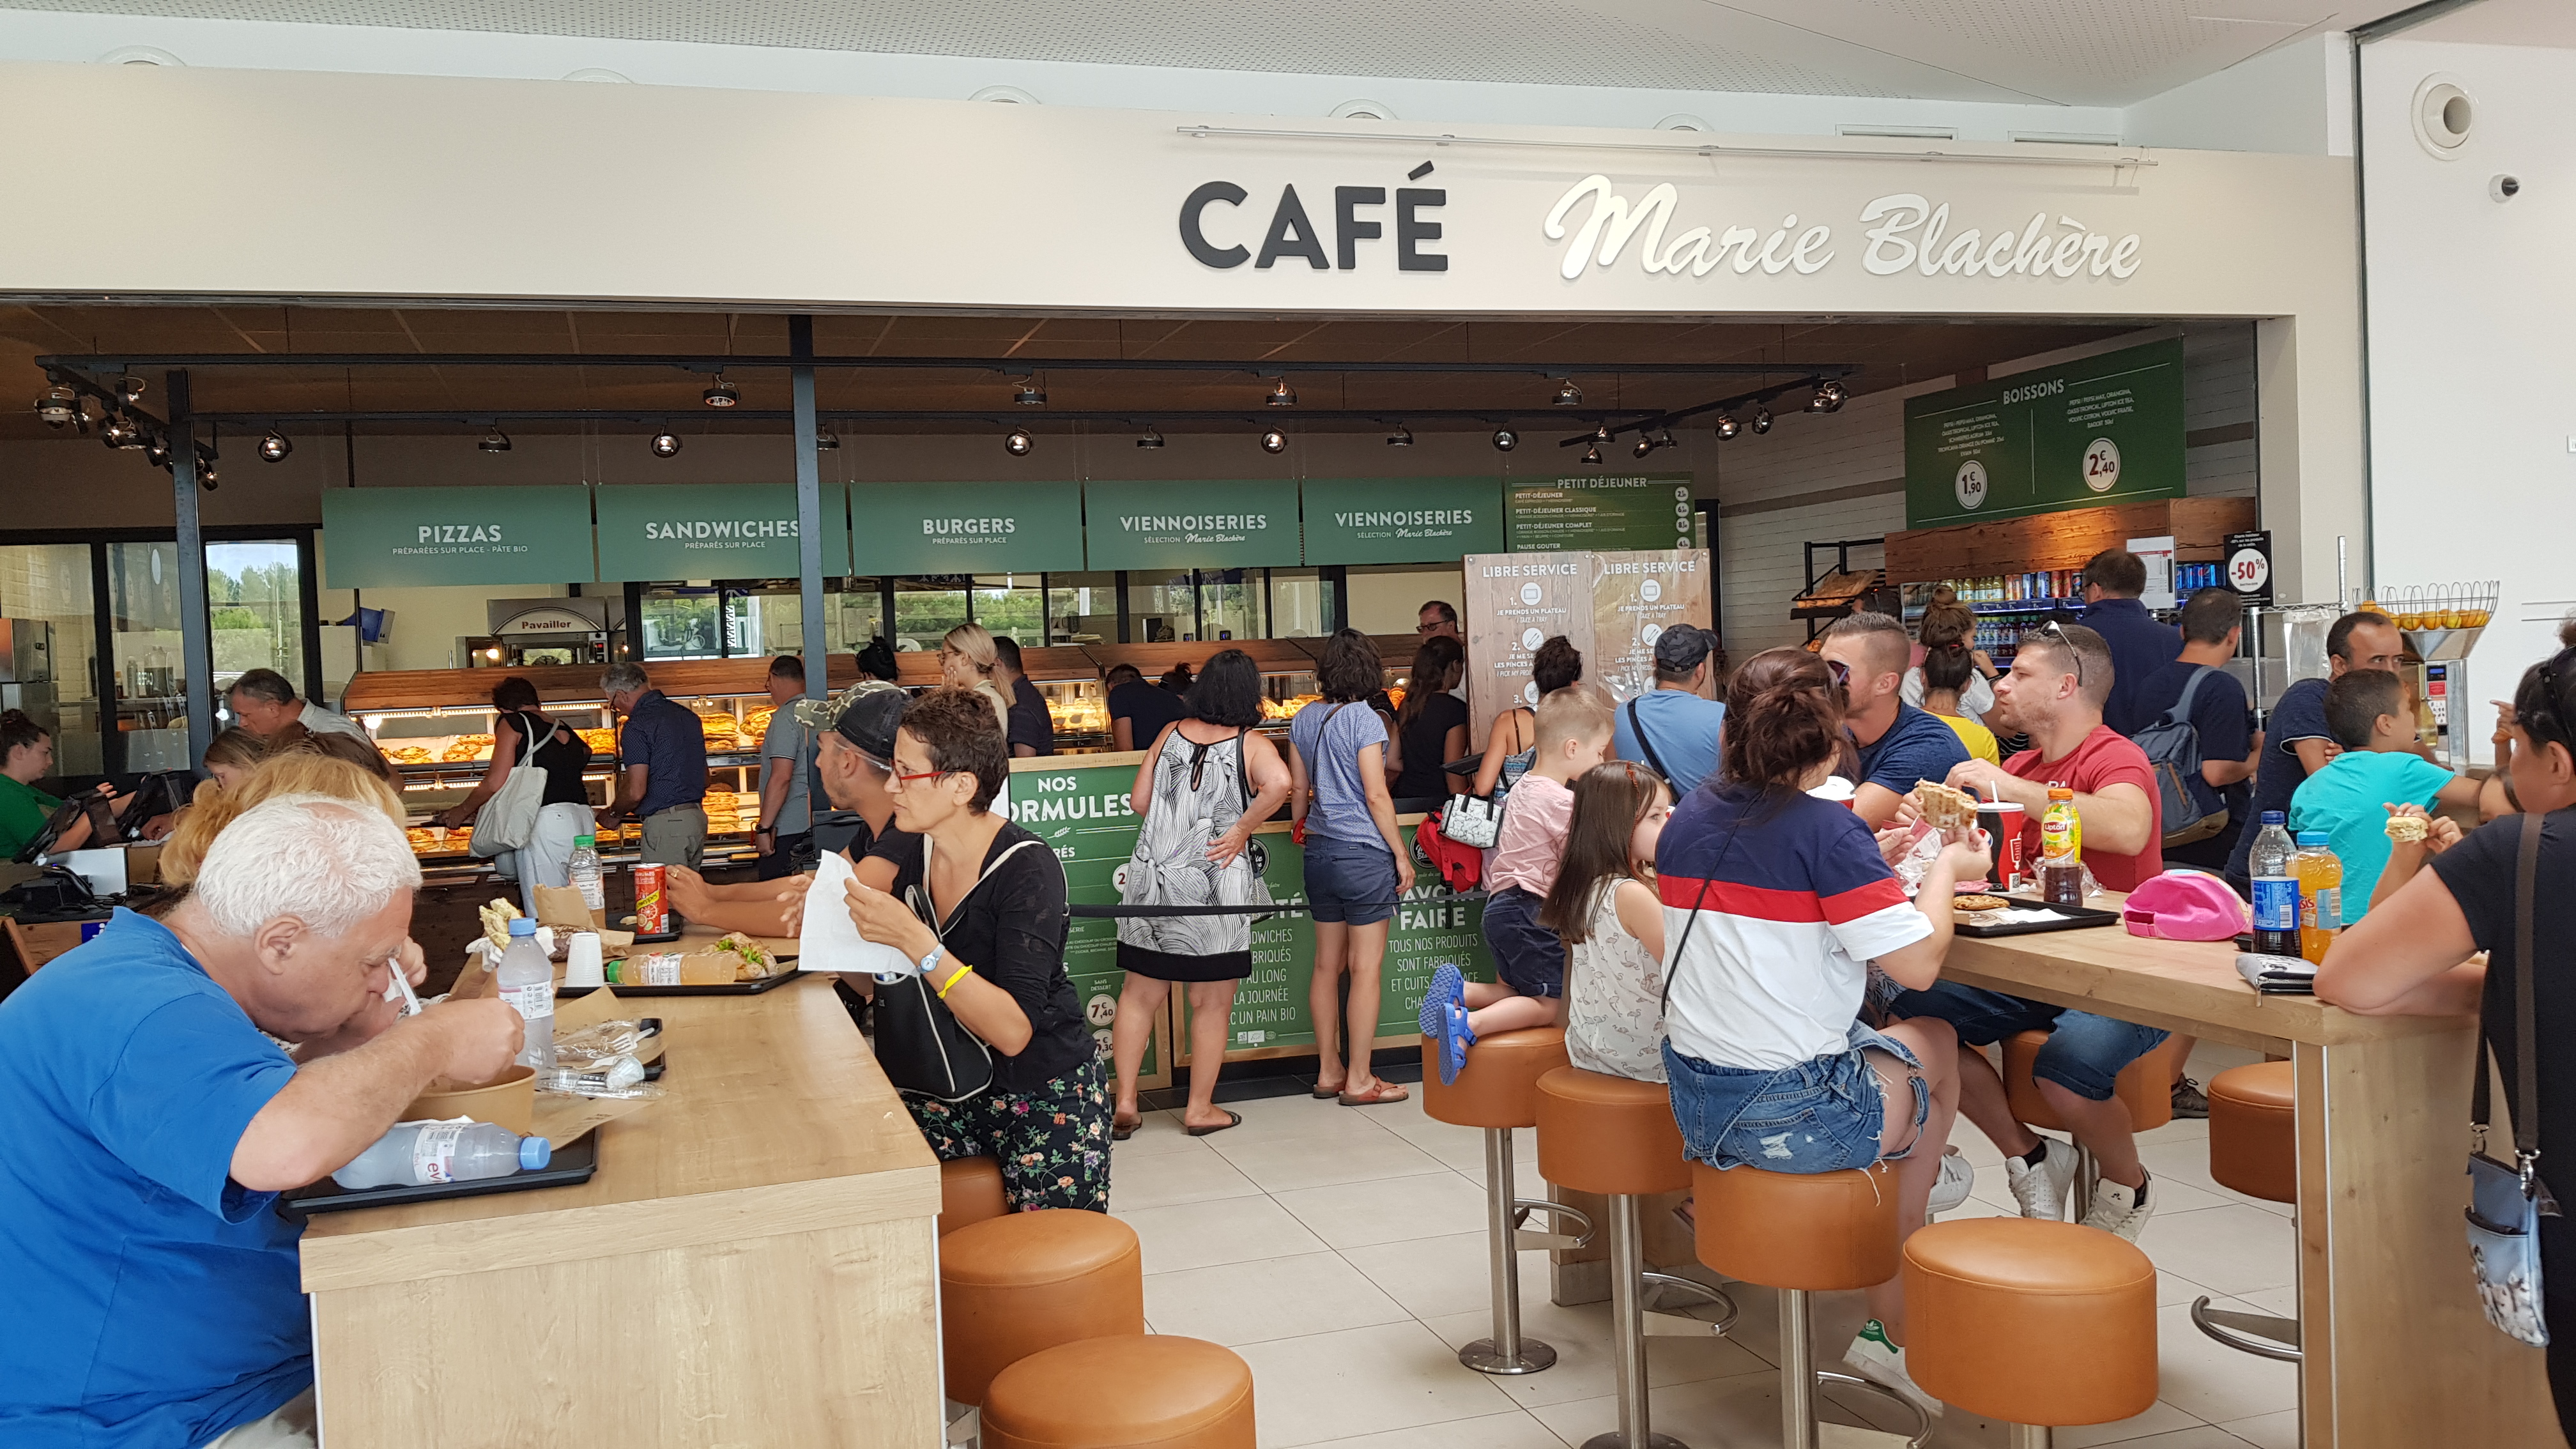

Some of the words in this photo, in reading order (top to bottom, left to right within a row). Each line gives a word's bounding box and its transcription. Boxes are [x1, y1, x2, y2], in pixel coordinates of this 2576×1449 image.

[1178, 160, 1449, 272] CAFÉ
[1543, 174, 1835, 280] Marie
[1859, 193, 2141, 278] Blachère
[2003, 379, 2064, 404] BOISSONS
[1557, 478, 1588, 489] PETIT
[1590, 475, 1647, 488] DÉJEUNER
[923, 518, 1016, 535] BURGERS
[1120, 514, 1267, 532] VIENNOISERIES
[1335, 509, 1473, 528] VIENNOISERIES
[1516, 521, 1564, 530] PETIT-DÉJEUNER
[418, 525, 502, 544] PIZZAS
[645, 519, 801, 540] SANDWICHES
[1357, 530, 1392, 539] SÉLECTION
[1395, 528, 1423, 539] Marie
[685, 540, 723, 550] PRÉPARÉS
[742, 540, 766, 549] PLACE
[932, 536, 968, 545] PRÉPARÉS
[1144, 535, 1181, 544] SÉLECTION
[1184, 533, 1214, 543] Marie
[392, 545, 438, 556] PRÉPARÉES
[440, 546, 456, 555] SUR
[458, 546, 485, 555] PLACE
[492, 543, 512, 554] PÂTE
[512, 544, 528, 554] BIO
[1482, 565, 1519, 578] LIBRE
[1522, 564, 1577, 577] SERVICE
[1604, 563, 1639, 575] LIBRE
[1643, 561, 1695, 573] SERVICE
[2231, 558, 2265, 580] -50%
[1510, 596, 1517, 606] 1.
[522, 620, 571, 629] Pavailler
[1512, 642, 1521, 651] 2.
[1631, 638, 1640, 646] 2.
[1513, 694, 1522, 703] 3.
[1038, 776, 1077, 793] NOS
[1011, 793, 1135, 823] RMULES
[2044, 822, 2066, 831] Lipton
[1053, 845, 1075, 858] RÉS
[2299, 897, 2315, 910] sis
[1400, 907, 1466, 930] FAIRE
[1250, 928, 1292, 945] DWICHES
[1388, 939, 1412, 953] TOUS
[1414, 937, 1432, 951] NOS
[1436, 933, 1478, 949] PRODUITS
[1252, 946, 1291, 964] BRIQUÉS
[1397, 957, 1421, 972] SONT
[1424, 951, 1471, 969] FABRIQUÉS
[1246, 970, 1258, 985] AU
[1262, 969, 1287, 983] LONG
[1391, 978, 1402, 992] ET
[1404, 976, 1430, 990] CUITS
[1463, 972, 1478, 983] ACE
[1234, 992, 1245, 1005] LA
[1247, 985, 1289, 1004] JOURNÉE
[1406, 995, 1425, 1010] CHA
[1239, 1010, 1253, 1024] UN
[1257, 1008, 1276, 1023] PAIN
[1281, 1007, 1296, 1021] BIO
[427, 1162, 445, 1183] evi
